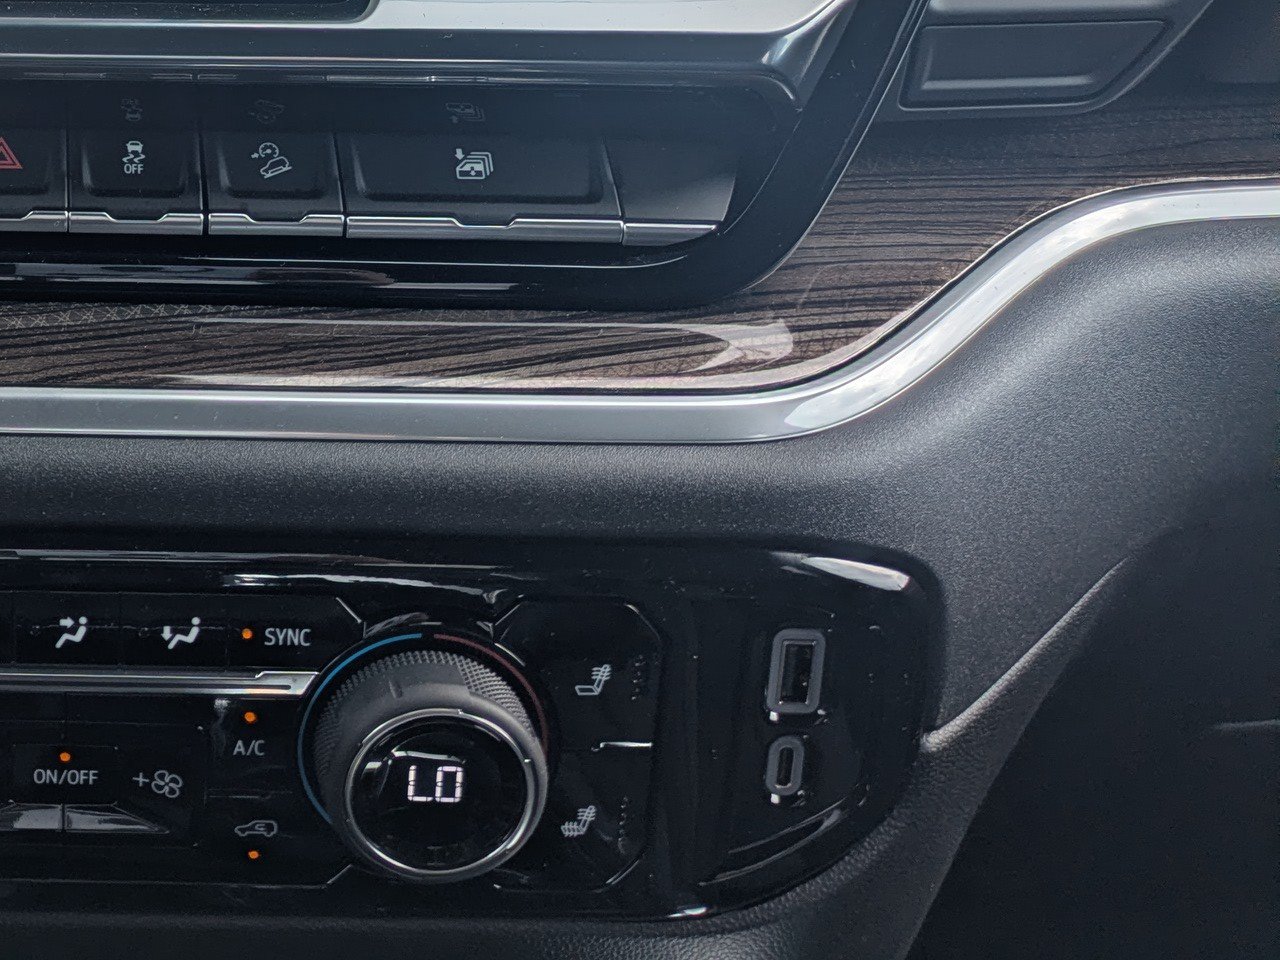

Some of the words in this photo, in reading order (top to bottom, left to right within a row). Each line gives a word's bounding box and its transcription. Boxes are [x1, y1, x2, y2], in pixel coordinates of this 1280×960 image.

[124, 164, 144, 174] OFF
[264, 628, 311, 647] SYNC
[233, 740, 264, 757] A/C
[34, 769, 99, 786] ON/OFF
[408, 765, 463, 803] LO
